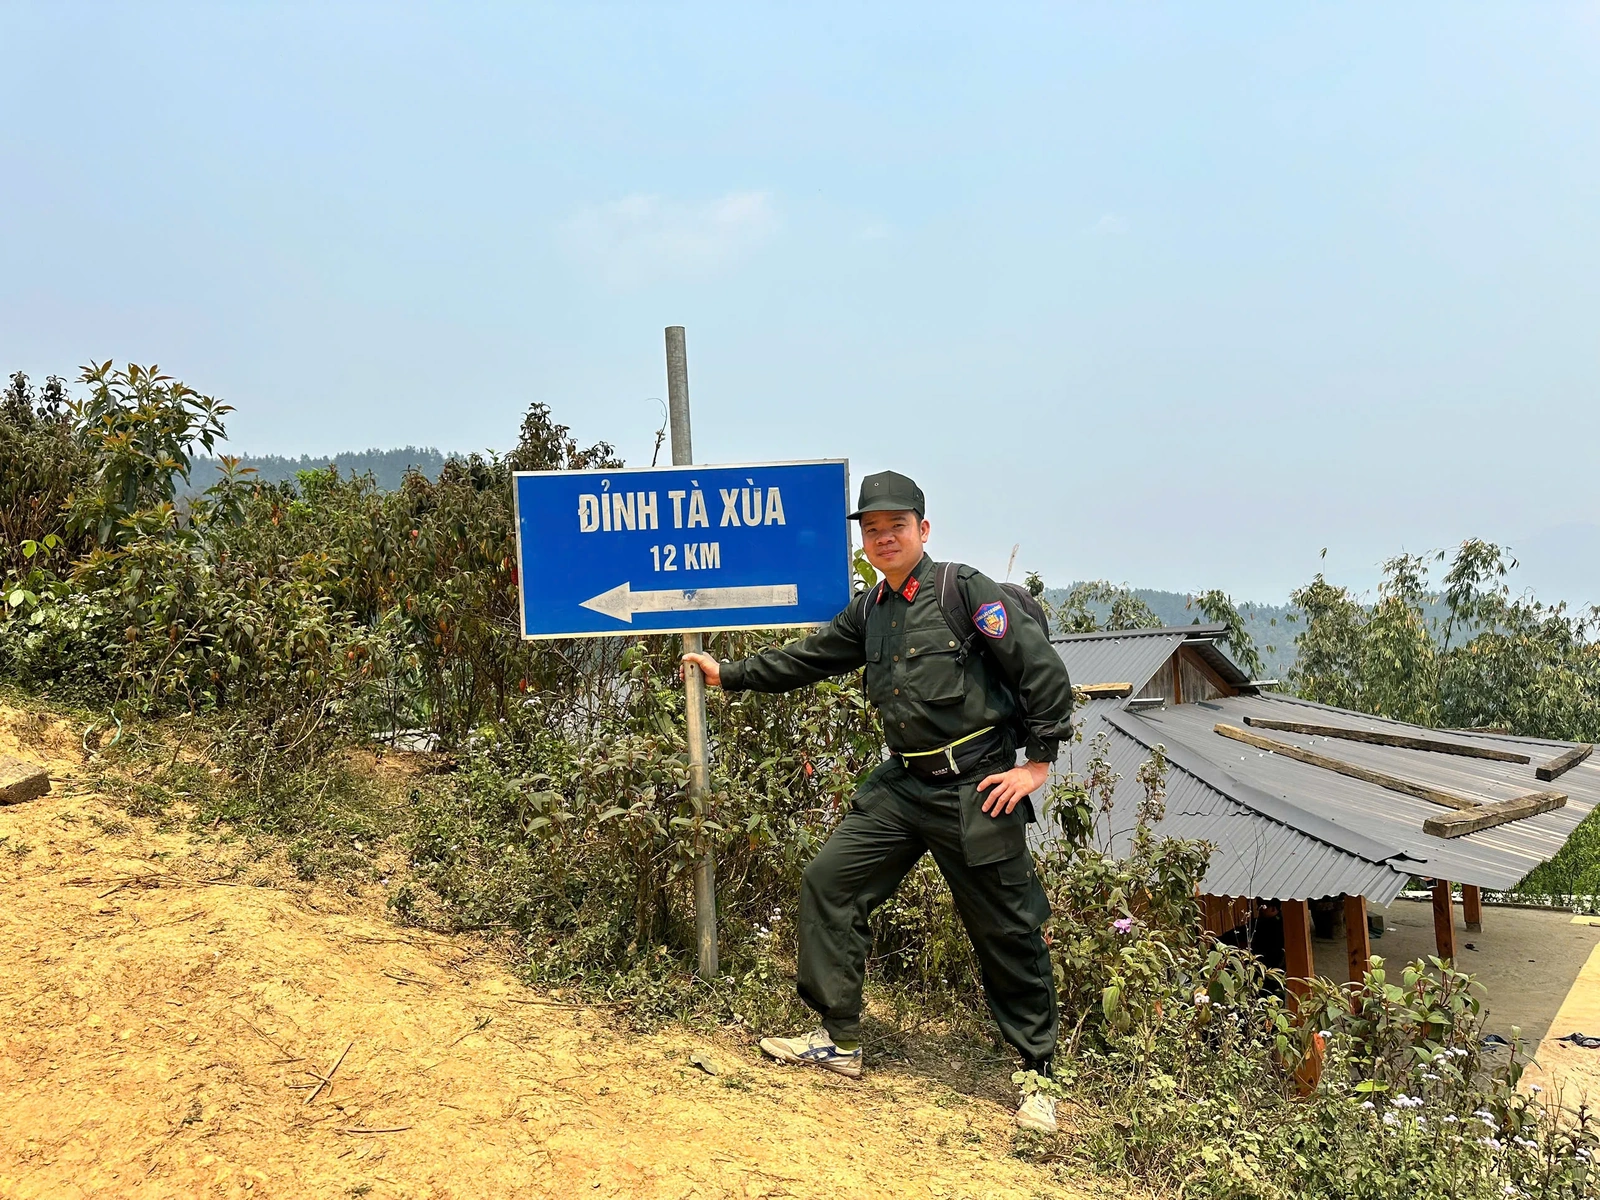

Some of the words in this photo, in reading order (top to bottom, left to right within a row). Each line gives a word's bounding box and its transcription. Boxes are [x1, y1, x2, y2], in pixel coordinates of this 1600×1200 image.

[577, 479, 659, 532] ĐỈNH
[668, 480, 710, 528] TÀ
[719, 478, 786, 527] XÙA
[649, 545, 678, 571] 12
[683, 542, 721, 570] KM
